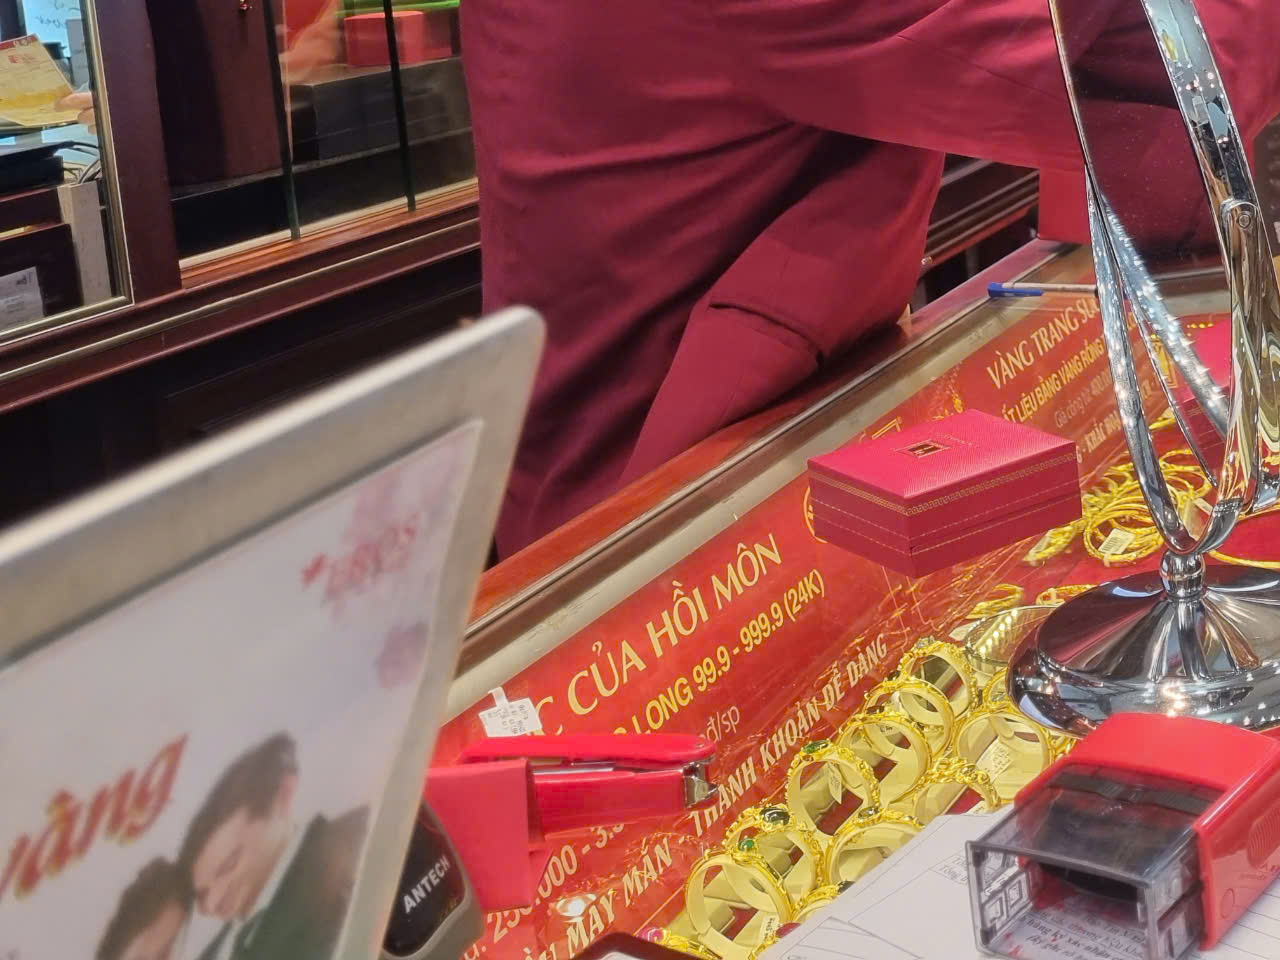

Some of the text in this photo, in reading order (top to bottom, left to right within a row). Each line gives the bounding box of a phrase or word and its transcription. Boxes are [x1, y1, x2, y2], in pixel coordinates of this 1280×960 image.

[987, 340, 1034, 389] VÀNG
[1031, 307, 1079, 356] TRANG
[567, 640, 647, 716] CỦA
[645, 579, 710, 657] HỒI
[710, 533, 784, 610] MÔN
[692, 645, 732, 692] 99.9
[739, 604, 785, 653] 999.9
[783, 568, 826, 621] (24K)
[759, 697, 821, 772] KHOẢN
[846, 633, 888, 688] DÀNG
[403, 854, 450, 914] ANTECH
